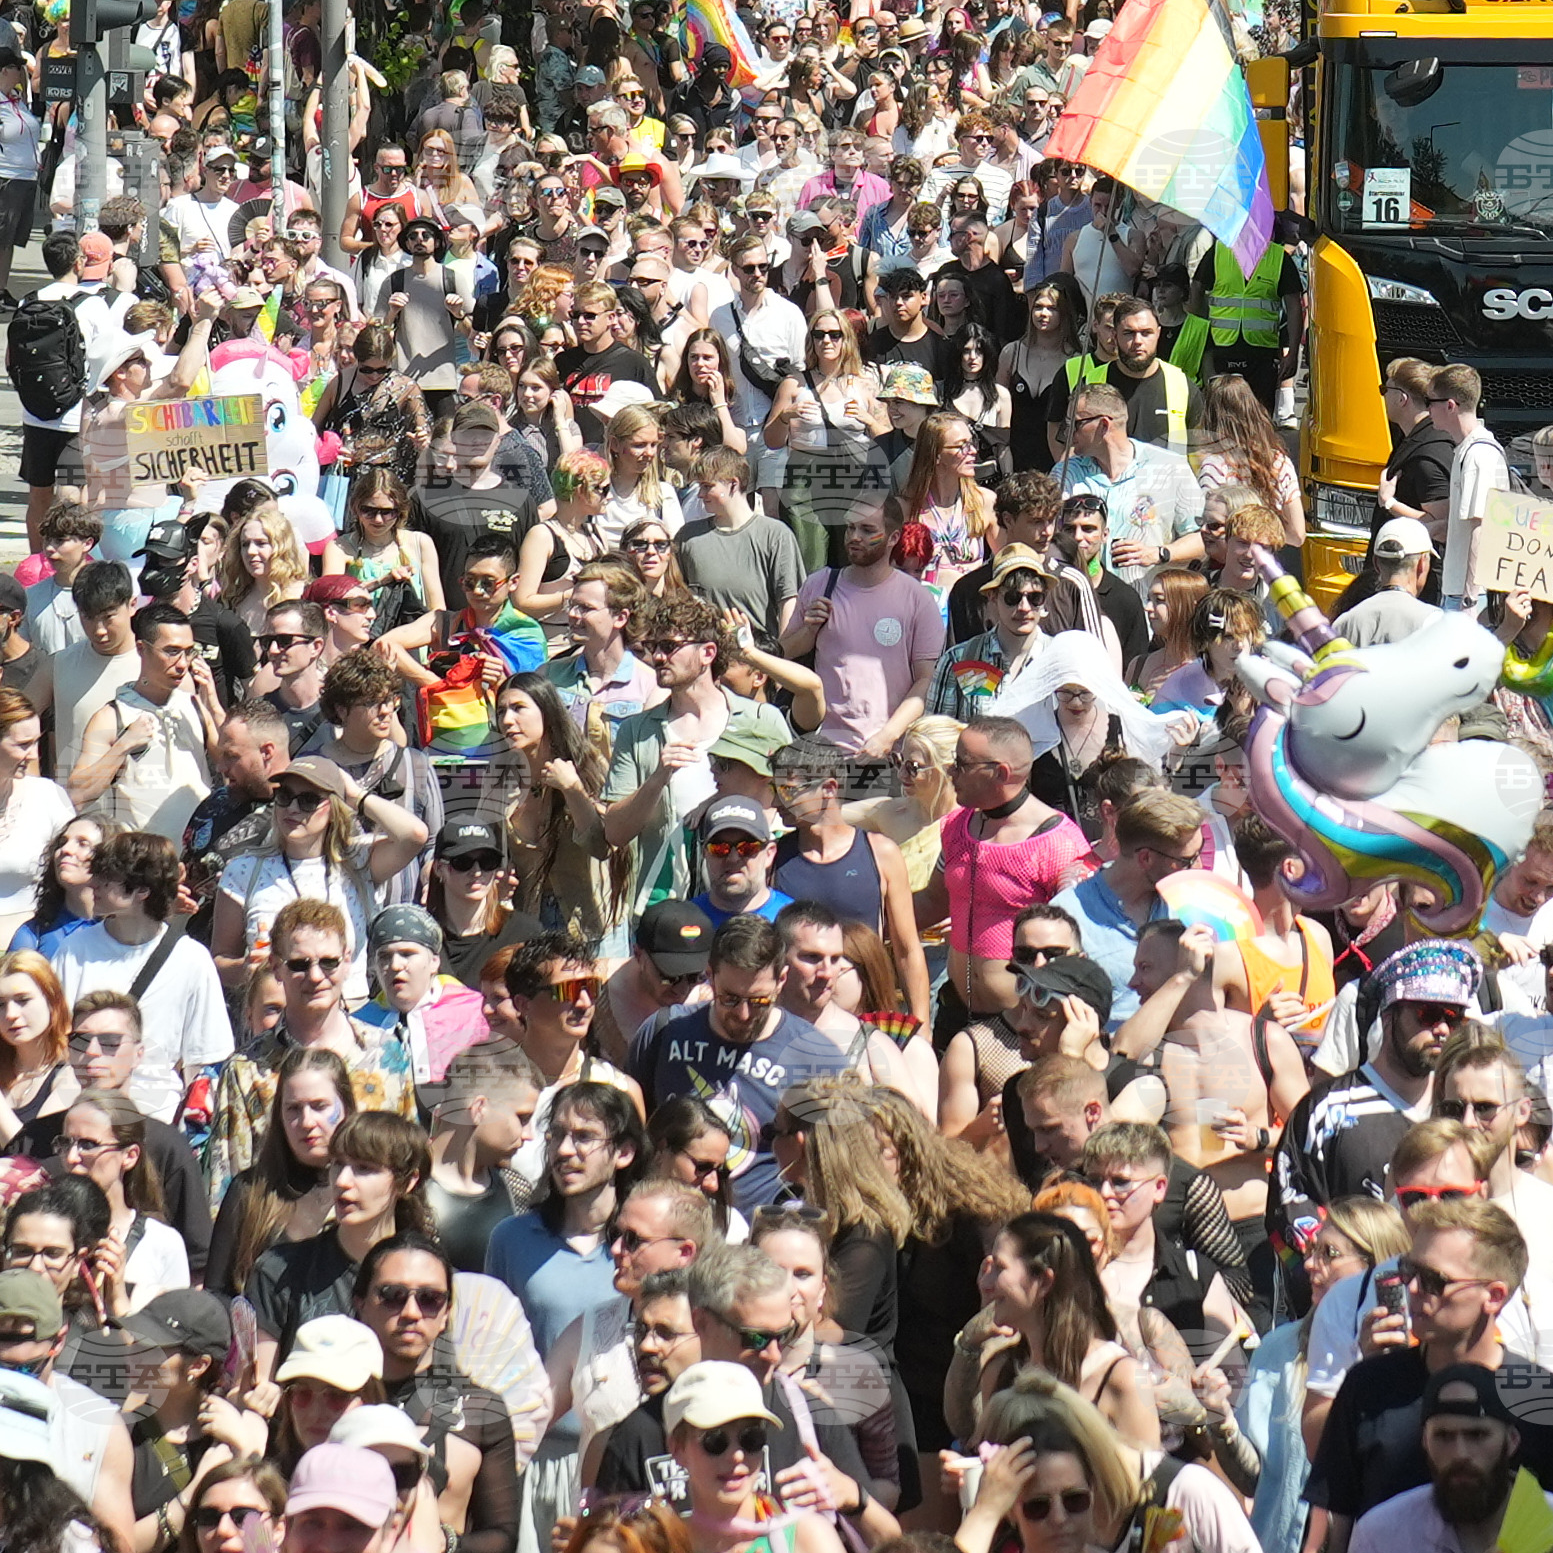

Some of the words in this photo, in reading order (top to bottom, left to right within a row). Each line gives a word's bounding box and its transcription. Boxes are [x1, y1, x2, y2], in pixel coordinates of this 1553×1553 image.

[1372, 197, 1400, 222] 16
[129, 397, 256, 434] SICHTBARKEIT
[134, 441, 259, 481] SICHERHEIT
[710, 804, 757, 821] adidas
[668, 1039, 710, 1063] ALT
[715, 1045, 786, 1087] MASC
